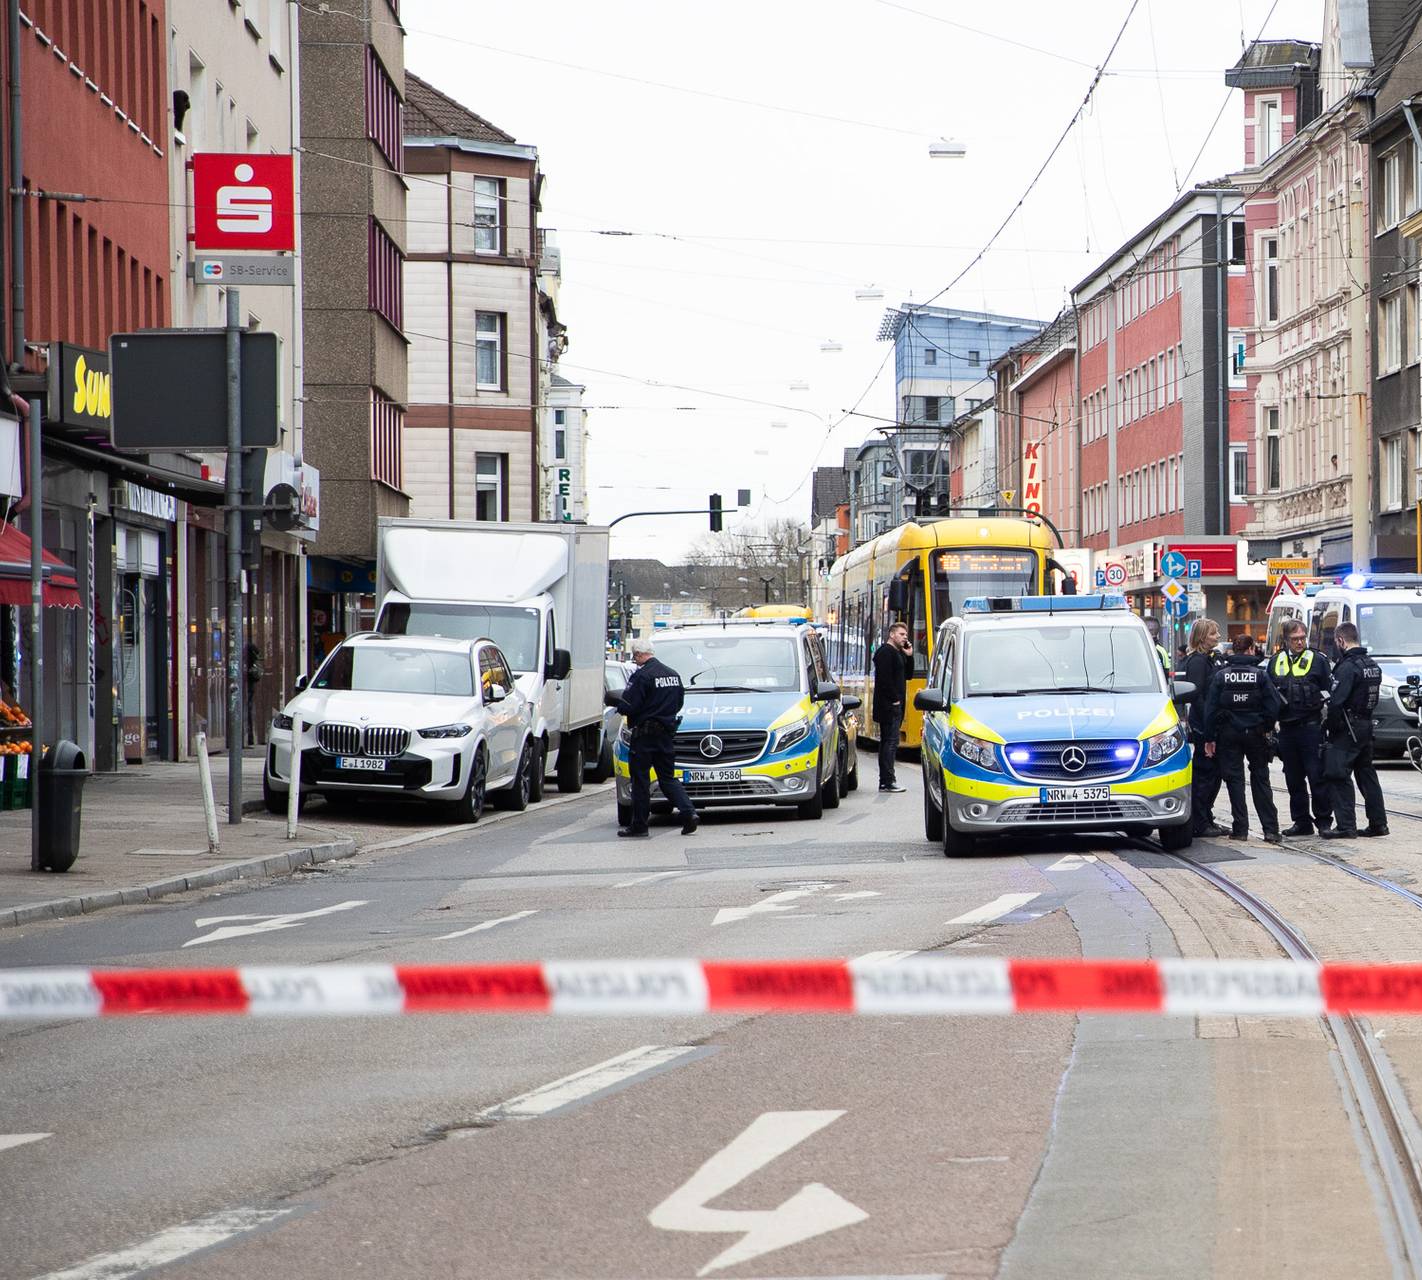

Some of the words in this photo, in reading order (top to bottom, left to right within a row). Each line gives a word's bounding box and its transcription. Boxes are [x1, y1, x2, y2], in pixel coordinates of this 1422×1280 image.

[229, 265, 288, 276] SB-Service
[1024, 442, 1041, 518] KINO
[1109, 570, 1123, 580] 30
[1190, 562, 1199, 577] P
[654, 676, 681, 688] POLIZEI
[1224, 672, 1257, 683] POLIZEI
[1233, 693, 1249, 702] DHF
[1016, 706, 1116, 721] POLIZEI
[688, 770, 706, 782] NRW
[1046, 789, 1067, 801] NRW
